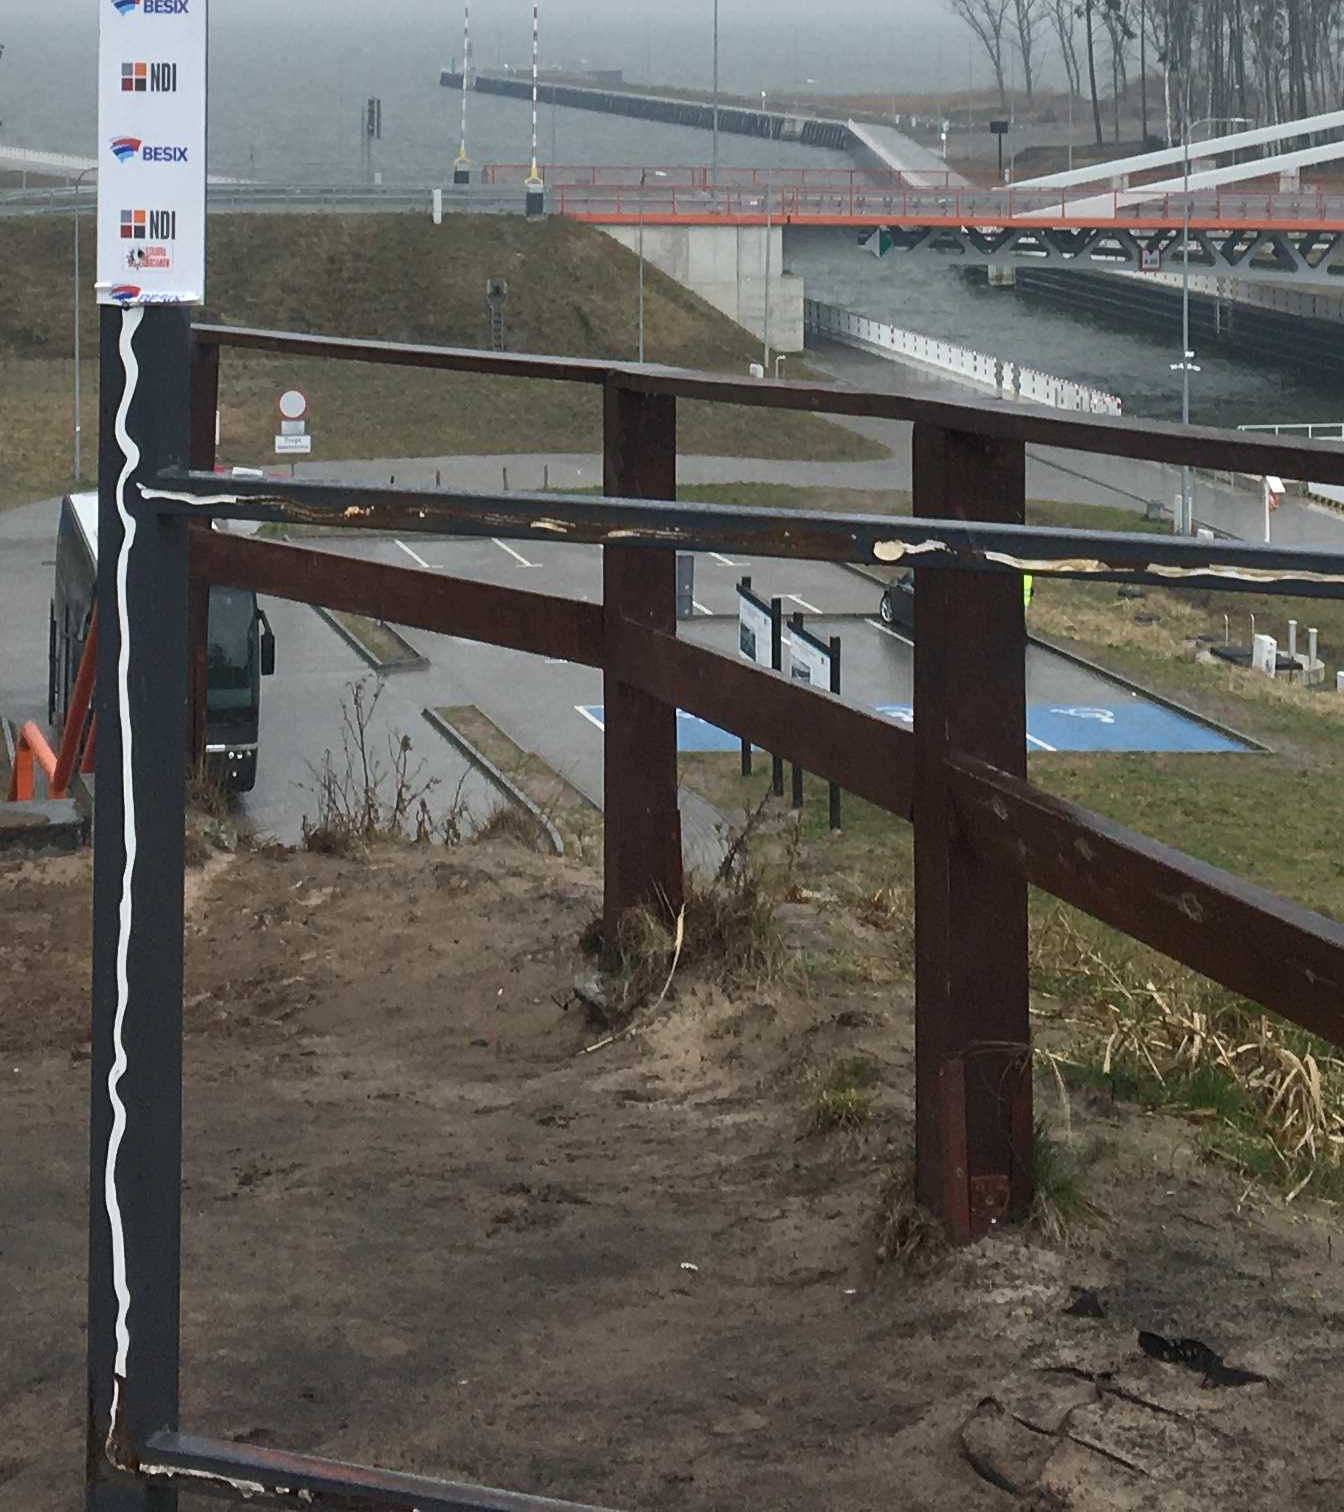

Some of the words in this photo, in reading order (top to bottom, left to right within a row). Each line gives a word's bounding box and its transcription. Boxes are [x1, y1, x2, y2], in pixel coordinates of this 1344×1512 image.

[150, 62, 177, 93] NDI
[142, 146, 189, 162] BESIX
[149, 210, 176, 241] NDI
